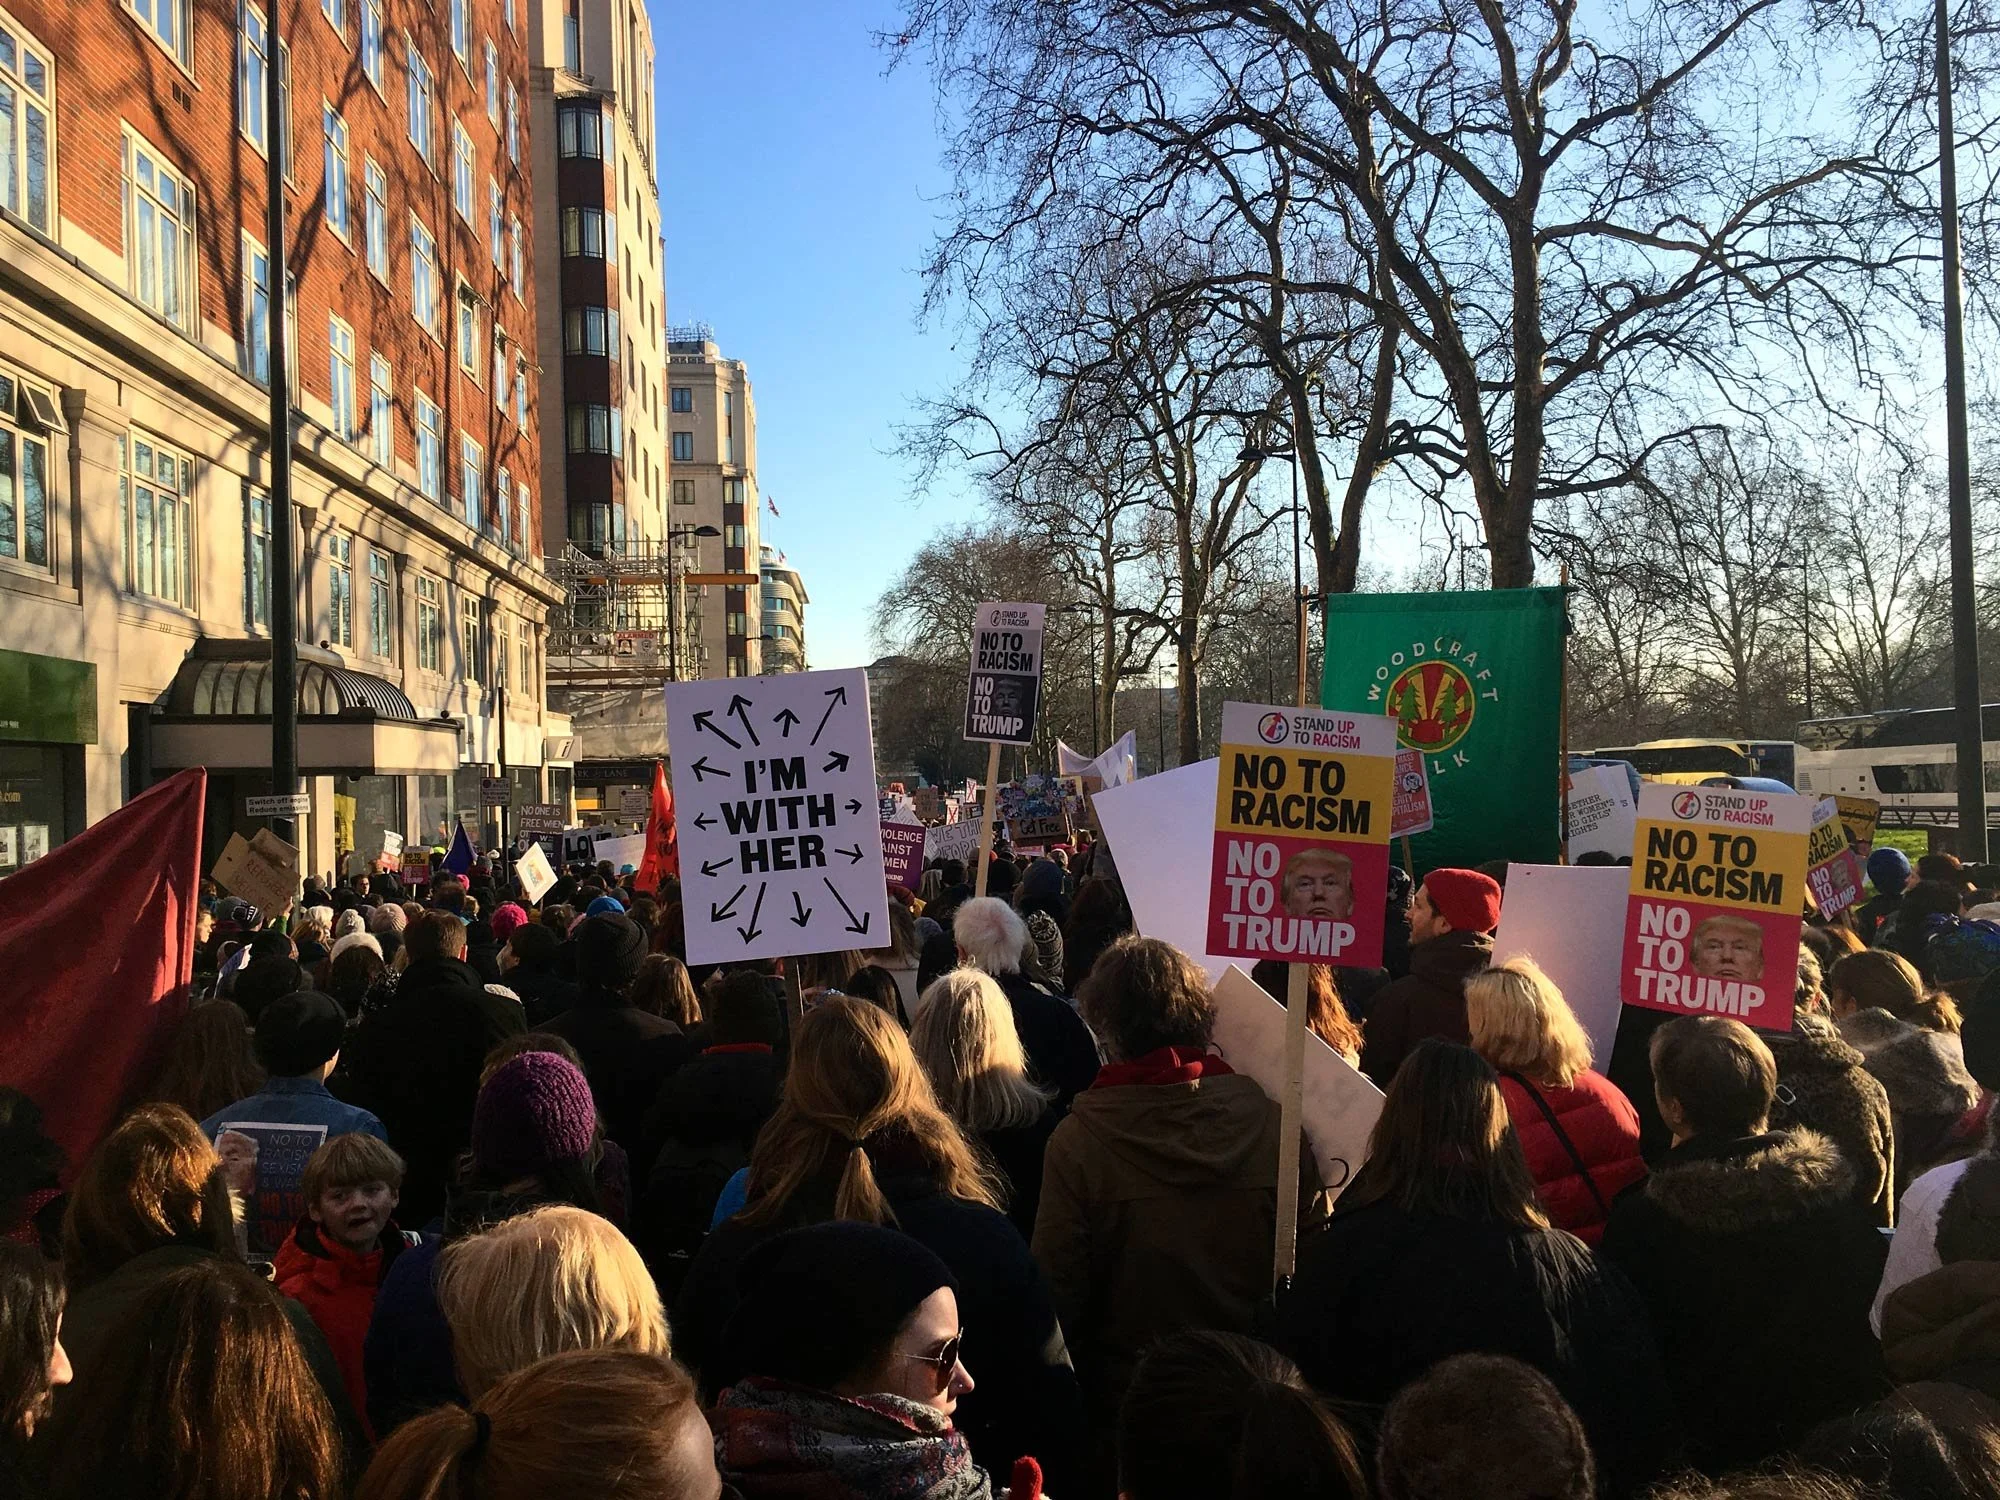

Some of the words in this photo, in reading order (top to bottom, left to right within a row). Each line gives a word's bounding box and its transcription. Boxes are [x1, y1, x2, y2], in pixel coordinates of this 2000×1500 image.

[1001, 610, 1019, 619] STAND
[1019, 611, 1028, 619] UP
[1007, 618, 1030, 627] RACISM
[980, 632, 999, 651] NO
[1001, 633, 1023, 652] TO
[977, 651, 1033, 672] RACISM
[1367, 636, 1499, 702] WOODCRAFT
[974, 676, 995, 696] NO
[973, 695, 991, 715] TO
[971, 714, 1024, 736] TRUMP
[1293, 717, 1335, 733] STAND
[1337, 720, 1355, 734] UP
[1293, 731, 1310, 745] TO
[1313, 733, 1361, 750] RACISM
[1433, 750, 1471, 774] LK
[604, 769, 628, 778] LANE
[744, 756, 807, 794] I'M
[1233, 753, 1287, 791] NO
[1298, 758, 1346, 796] TO
[249, 798, 276, 806] Switch
[249, 806, 278, 814] Reduce
[521, 805, 534, 816] NO
[535, 806, 551, 816] ONE
[552, 808, 561, 816] IS
[1392, 801, 1424, 816] PITALISM
[1568, 794, 1601, 809] ETHER
[1577, 798, 1615, 816] WOMEN'S
[1705, 795, 1746, 810] STAND
[1750, 799, 1768, 812] UP
[720, 793, 836, 835] WITH
[1230, 790, 1371, 835] RACISM
[1581, 808, 1611, 825] GIRLS'
[1705, 808, 1721, 821] TO
[1724, 810, 1774, 826] RACISM
[521, 818, 541, 828] FREE
[543, 819, 565, 829] WHEN
[1818, 824, 1833, 842] TO
[740, 834, 827, 875] HER
[882, 842, 912, 856] AINST
[1647, 827, 1698, 862] NO
[1708, 832, 1757, 868] TO
[884, 857, 908, 870] MEN
[1227, 840, 1281, 878] NO
[1644, 859, 1784, 905] RACISM
[1811, 867, 1830, 887] NO
[1225, 876, 1274, 914] TO
[1816, 882, 1833, 901] TO
[1820, 885, 1857, 921] TRUMP
[1639, 903, 1691, 940] NO
[1222, 913, 1356, 957] TRUMP
[1637, 936, 1685, 972] TO
[1634, 968, 1766, 1017] TRUMP
[269, 1134, 291, 1146] NO
[295, 1135, 313, 1147] TO
